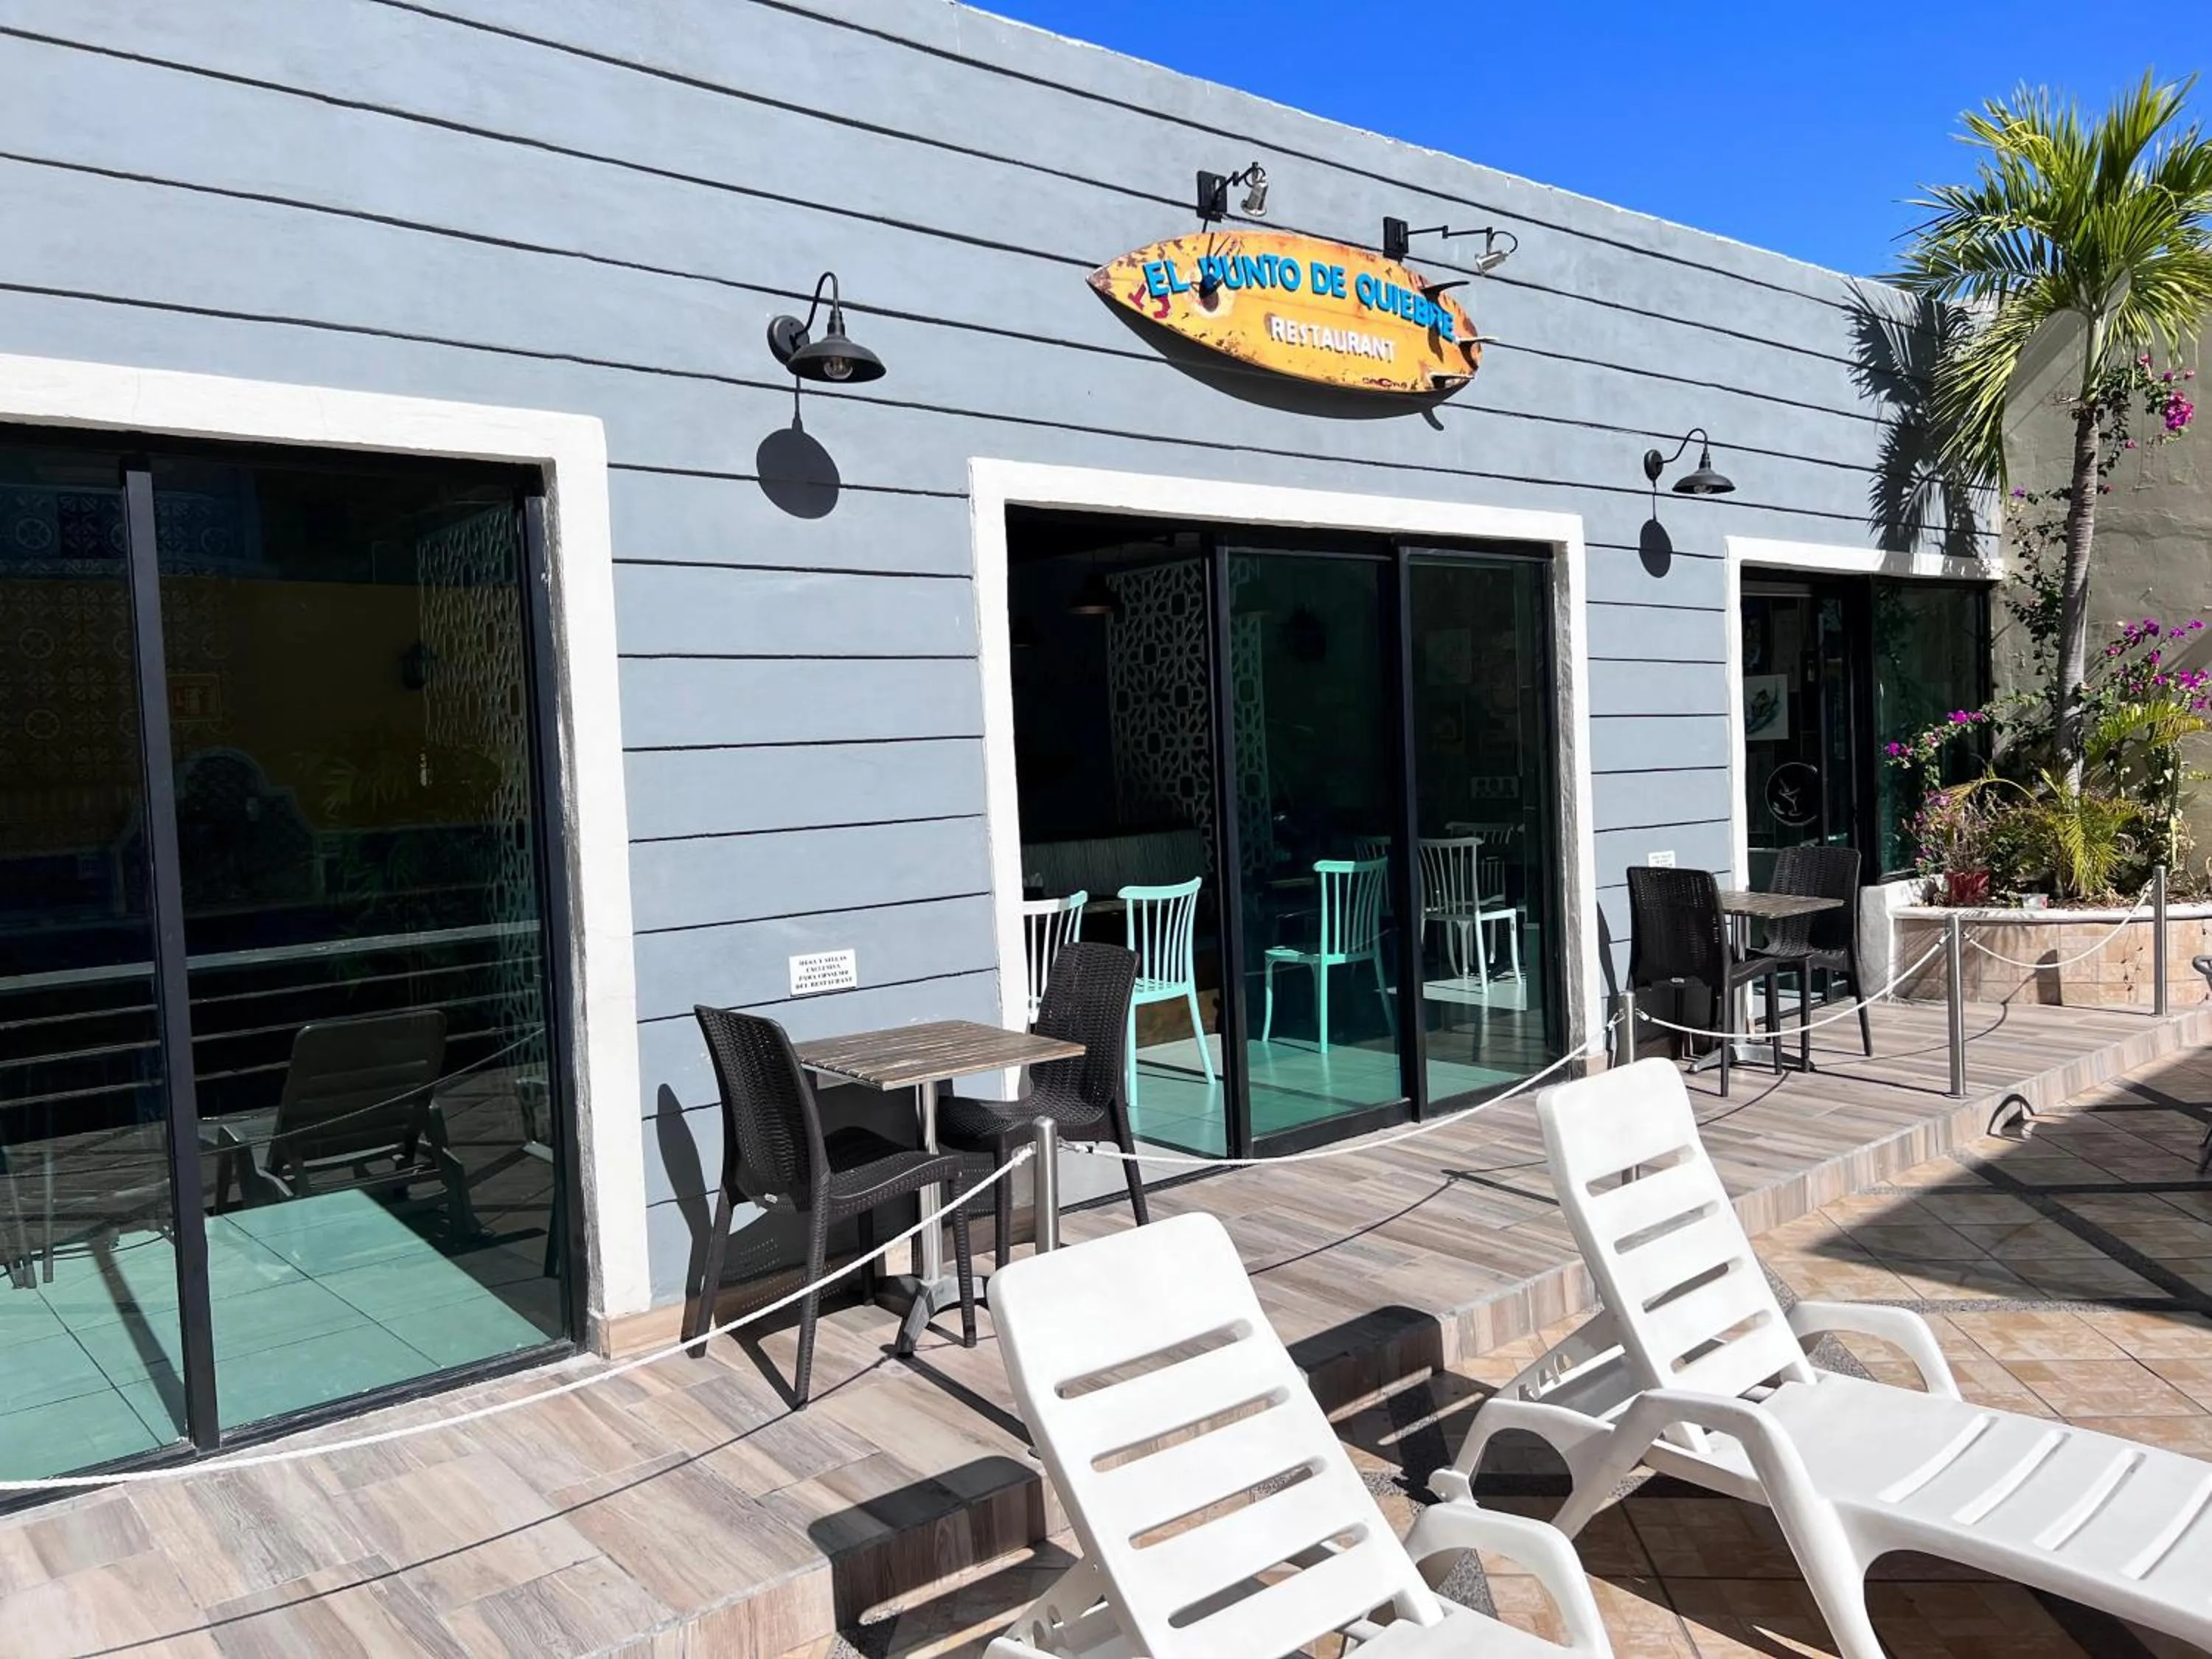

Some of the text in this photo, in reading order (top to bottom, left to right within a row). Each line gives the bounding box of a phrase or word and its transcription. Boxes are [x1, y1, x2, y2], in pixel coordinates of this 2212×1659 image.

[1143, 259, 1192, 299] EL
[1310, 260, 1347, 300] DE
[1354, 272, 1455, 344] QUIEBRE
[1270, 316, 1397, 364] RESTAURANT
